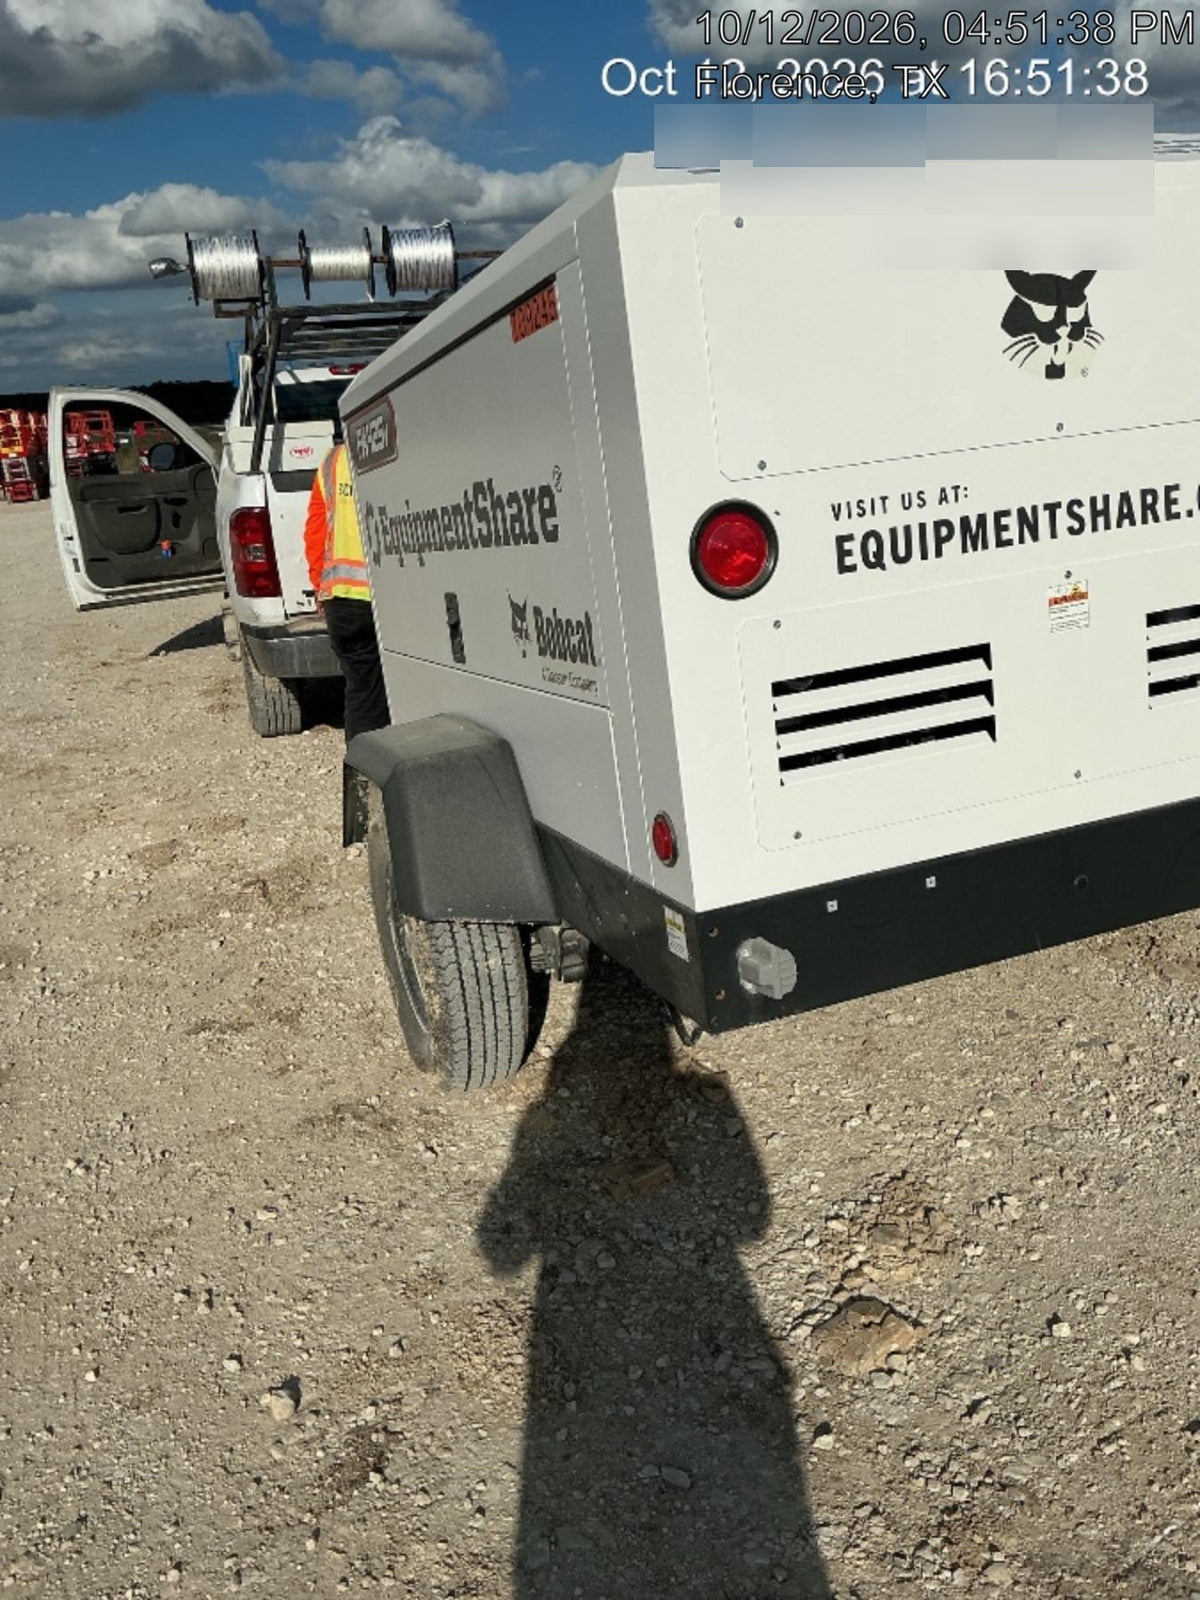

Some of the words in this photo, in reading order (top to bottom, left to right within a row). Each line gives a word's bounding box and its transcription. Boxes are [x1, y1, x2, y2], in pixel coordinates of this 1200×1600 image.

[830, 495, 890, 522] VISIT
[900, 489, 928, 512] US
[937, 484, 970, 507] AT:
[834, 482, 1200, 575] EQUIPMENTSHARE.
[532, 605, 597, 668] Bobcat
